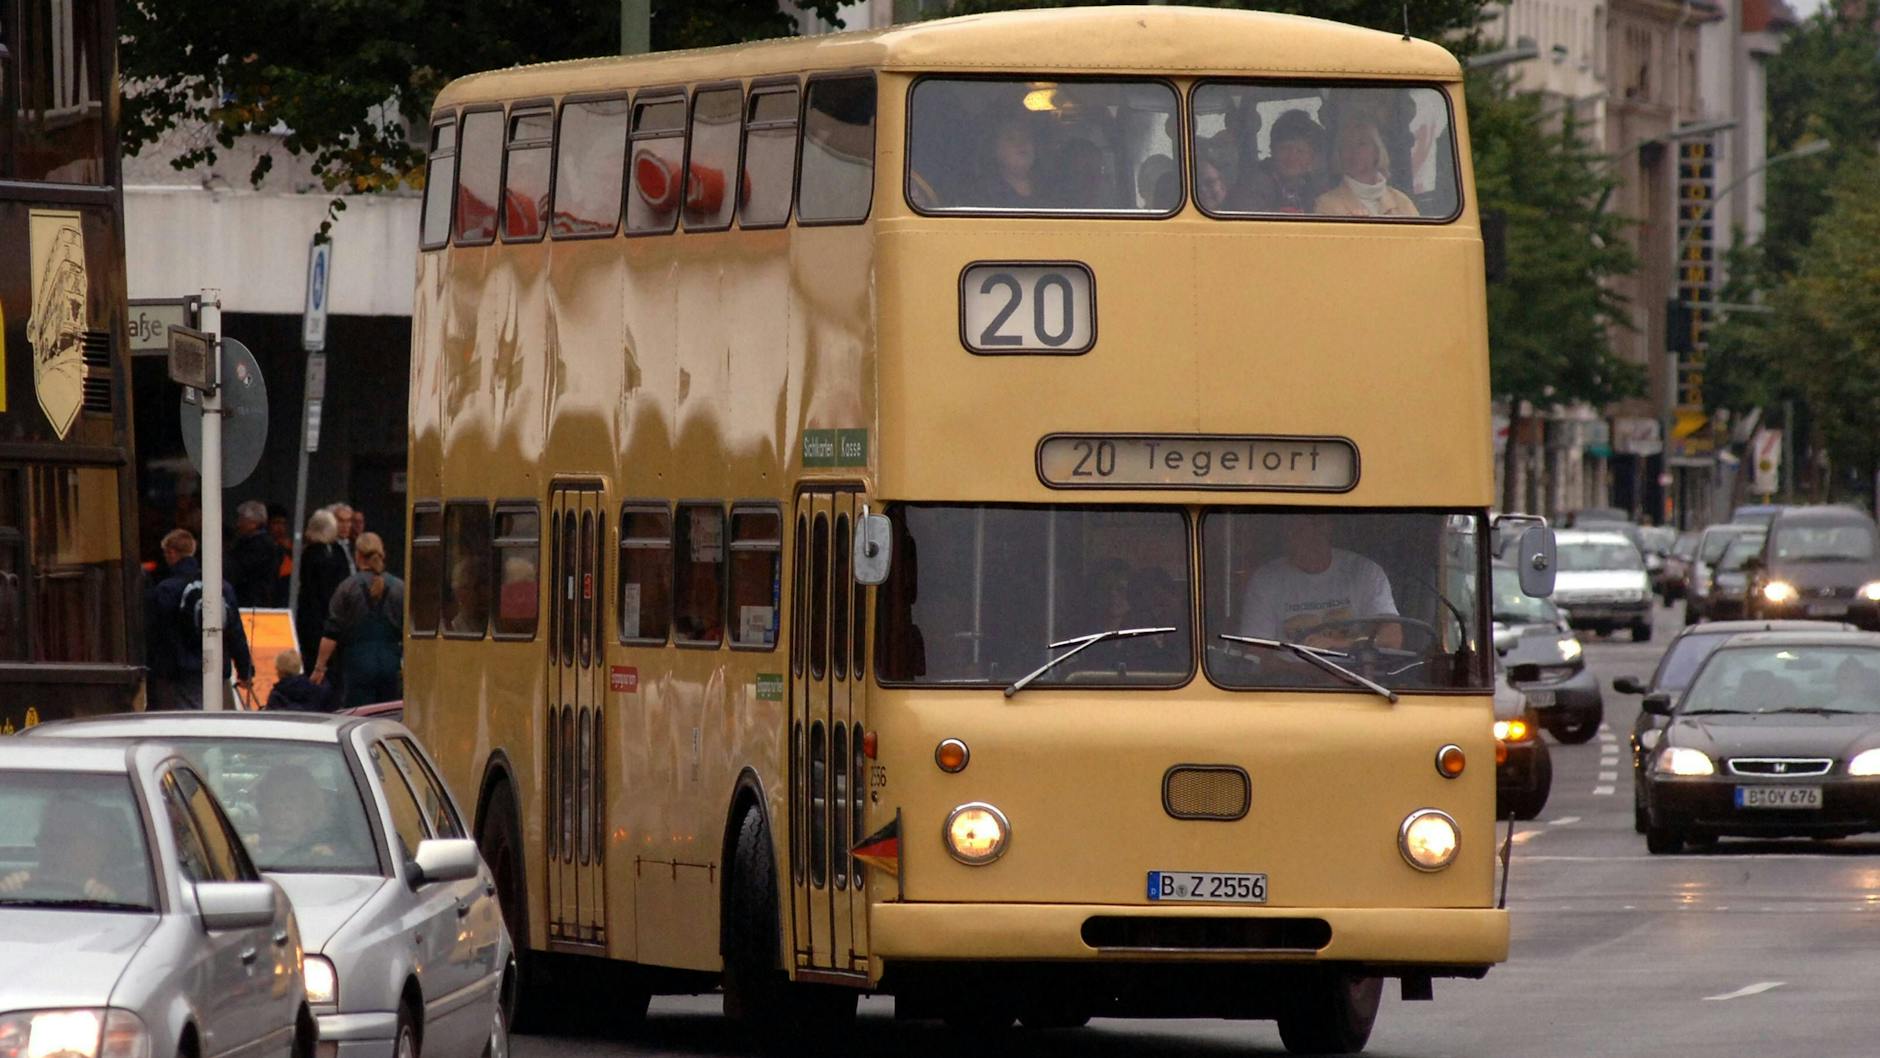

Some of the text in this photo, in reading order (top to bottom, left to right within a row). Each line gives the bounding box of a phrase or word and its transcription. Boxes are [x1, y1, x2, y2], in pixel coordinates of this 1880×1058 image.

[979, 273, 1074, 348] 20
[841, 435, 862, 457] Kasse
[1071, 440, 1321, 477] 20 Tegelort
[870, 765, 886, 787] 2556
[1748, 789, 1758, 804] B
[1790, 789, 1817, 804] 676
[1161, 875, 1175, 896] B
[1190, 876, 1205, 897] Z
[1210, 876, 1265, 898] 2556
